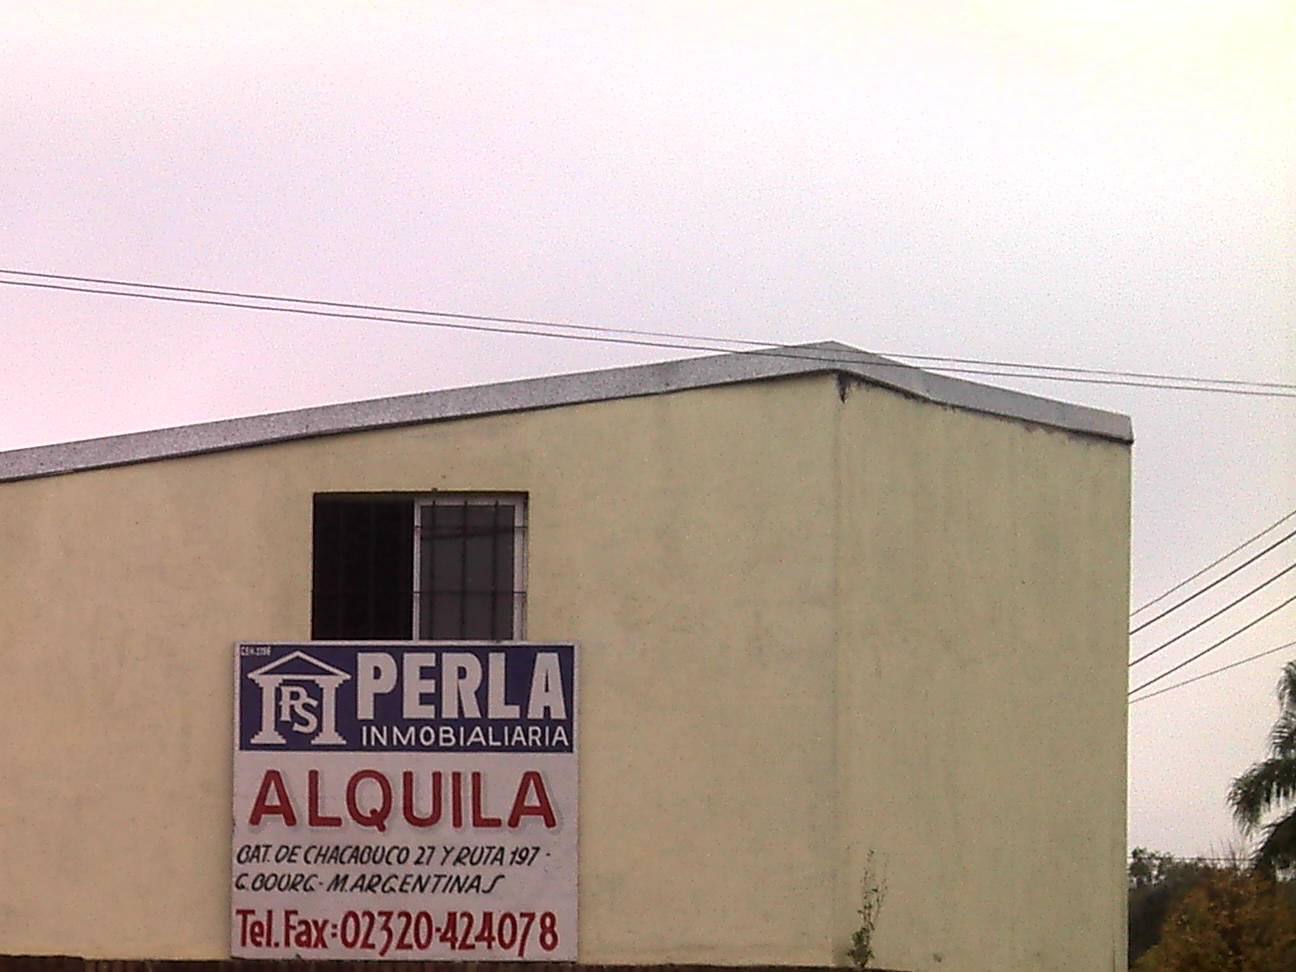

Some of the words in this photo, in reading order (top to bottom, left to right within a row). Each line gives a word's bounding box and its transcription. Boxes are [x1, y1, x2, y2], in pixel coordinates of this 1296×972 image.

[357, 652, 566, 720] PERLA
[362, 725, 569, 747] INMOBIALIARIA
[249, 769, 557, 832] ALQUILA
[303, 845, 410, 866] CHACABUCO
[414, 846, 435, 866] 27
[454, 846, 505, 867] RUTA
